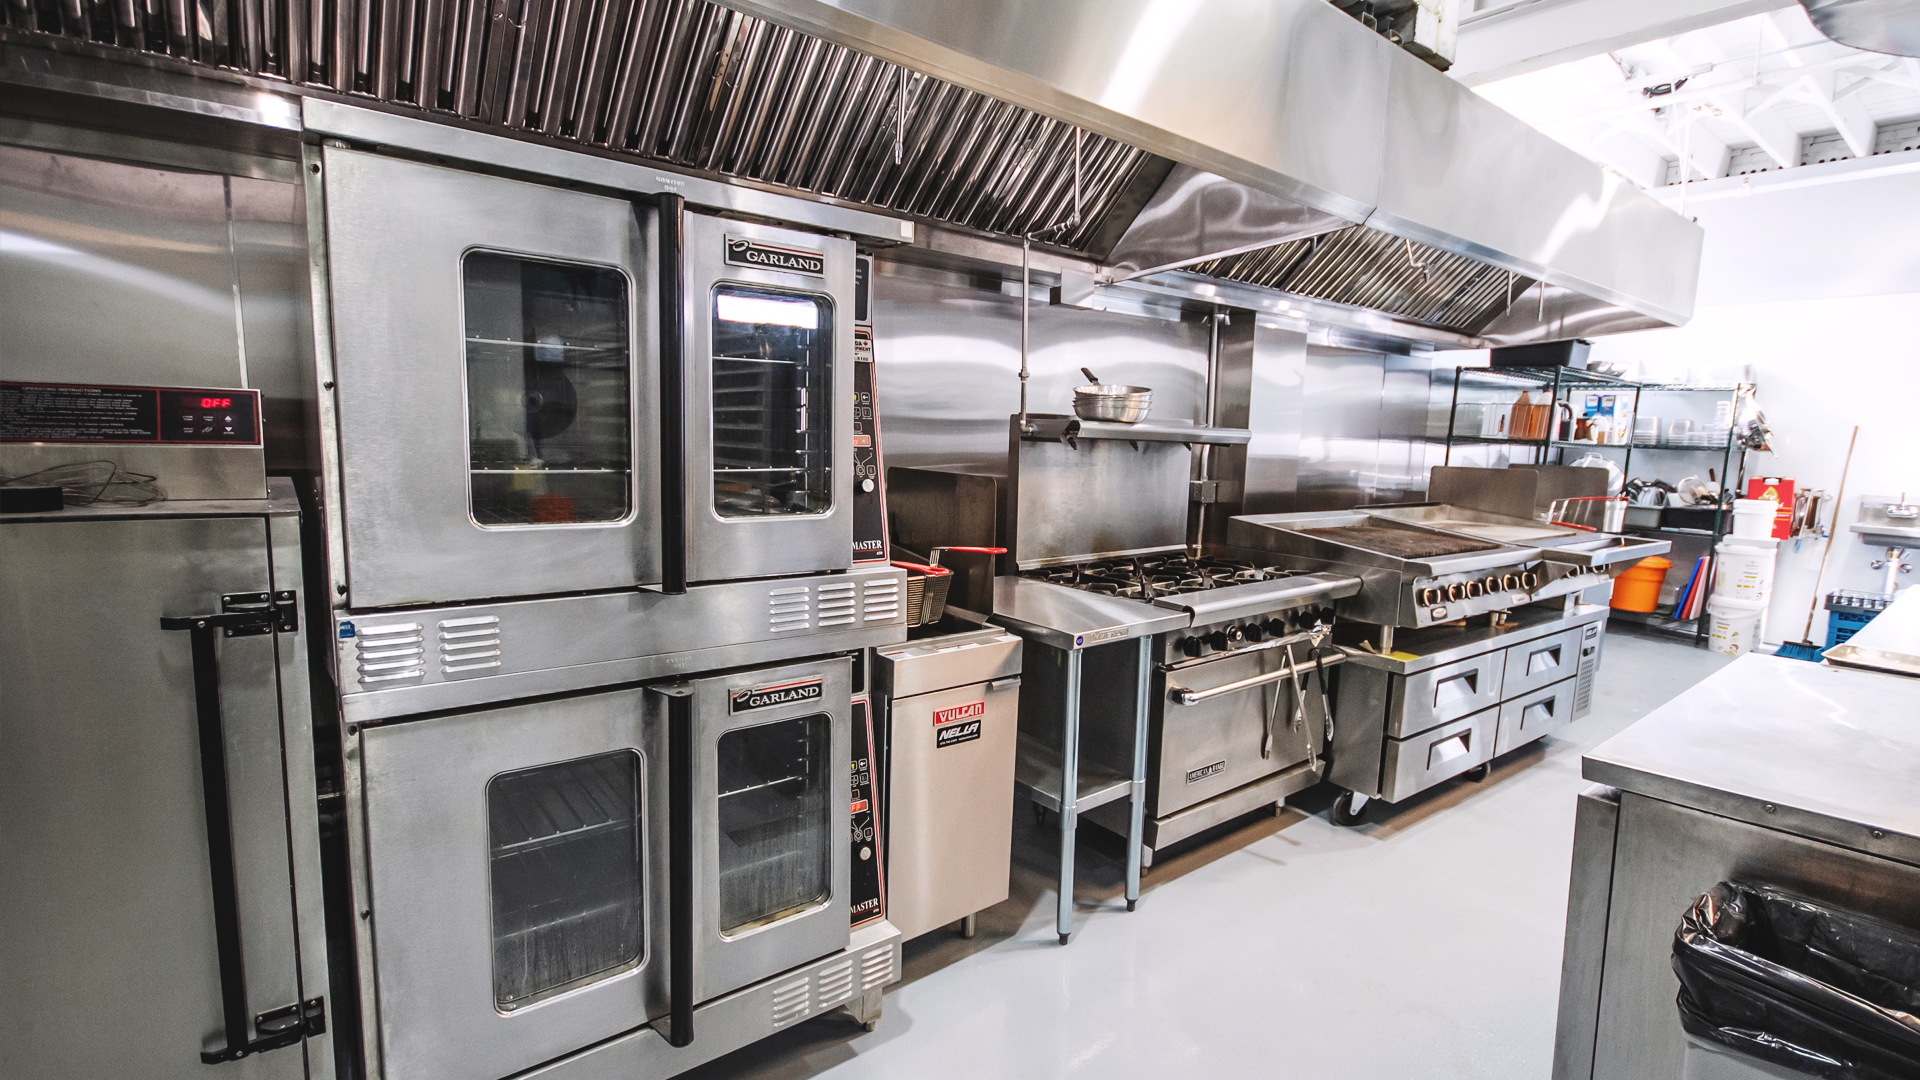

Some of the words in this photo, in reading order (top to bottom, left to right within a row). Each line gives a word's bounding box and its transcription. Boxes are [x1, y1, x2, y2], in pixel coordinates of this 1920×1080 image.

[746, 250, 821, 270] GARLAND
[201, 398, 231, 408] OFF
[852, 540, 882, 550] MASTER
[749, 686, 819, 707] GARLAND
[939, 703, 982, 722] VULCAN
[939, 723, 979, 740] NELLA
[850, 898, 878, 914] MASTER
